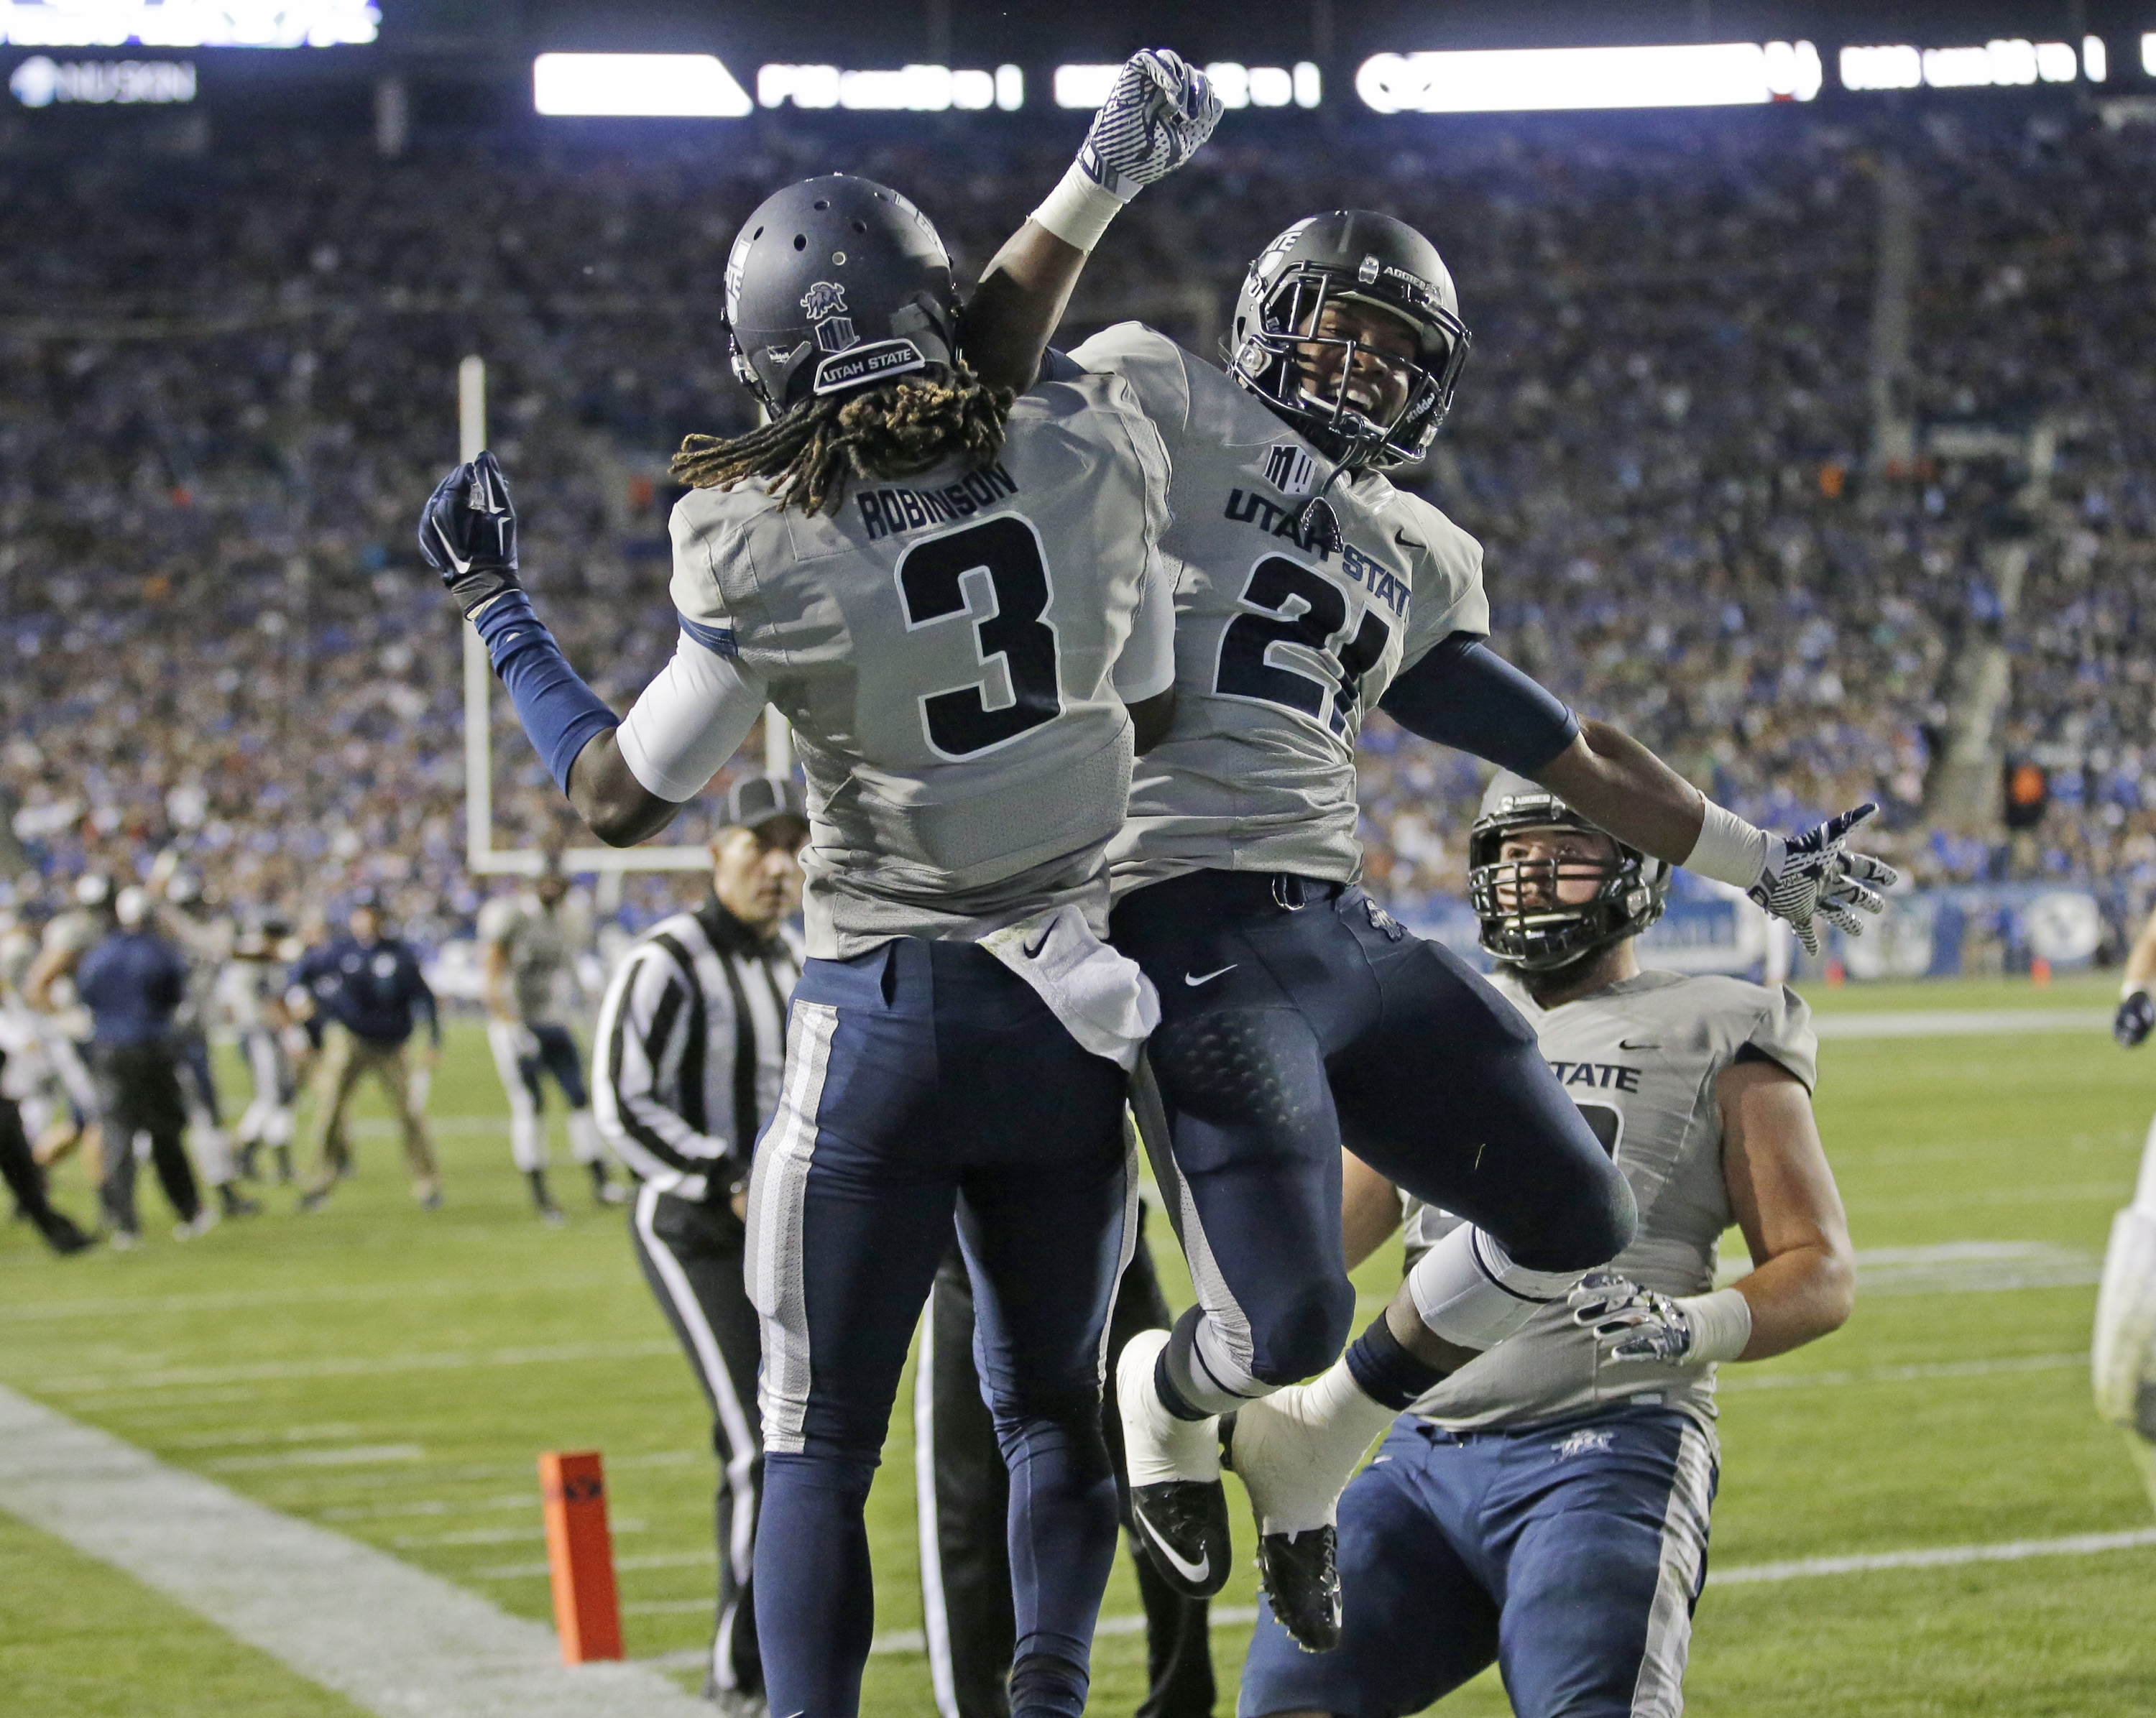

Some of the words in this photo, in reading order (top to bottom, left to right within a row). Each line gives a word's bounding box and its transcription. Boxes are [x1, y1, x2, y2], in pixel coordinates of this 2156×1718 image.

[823, 361, 865, 383] UTAH
[867, 348, 912, 370] STATE
[856, 461, 1019, 540] ROBINSON
[1263, 445, 1318, 494] MW
[1342, 543, 1413, 618] STAT
[894, 511, 1067, 763] 3
[1547, 1061, 1642, 1094] TATE
